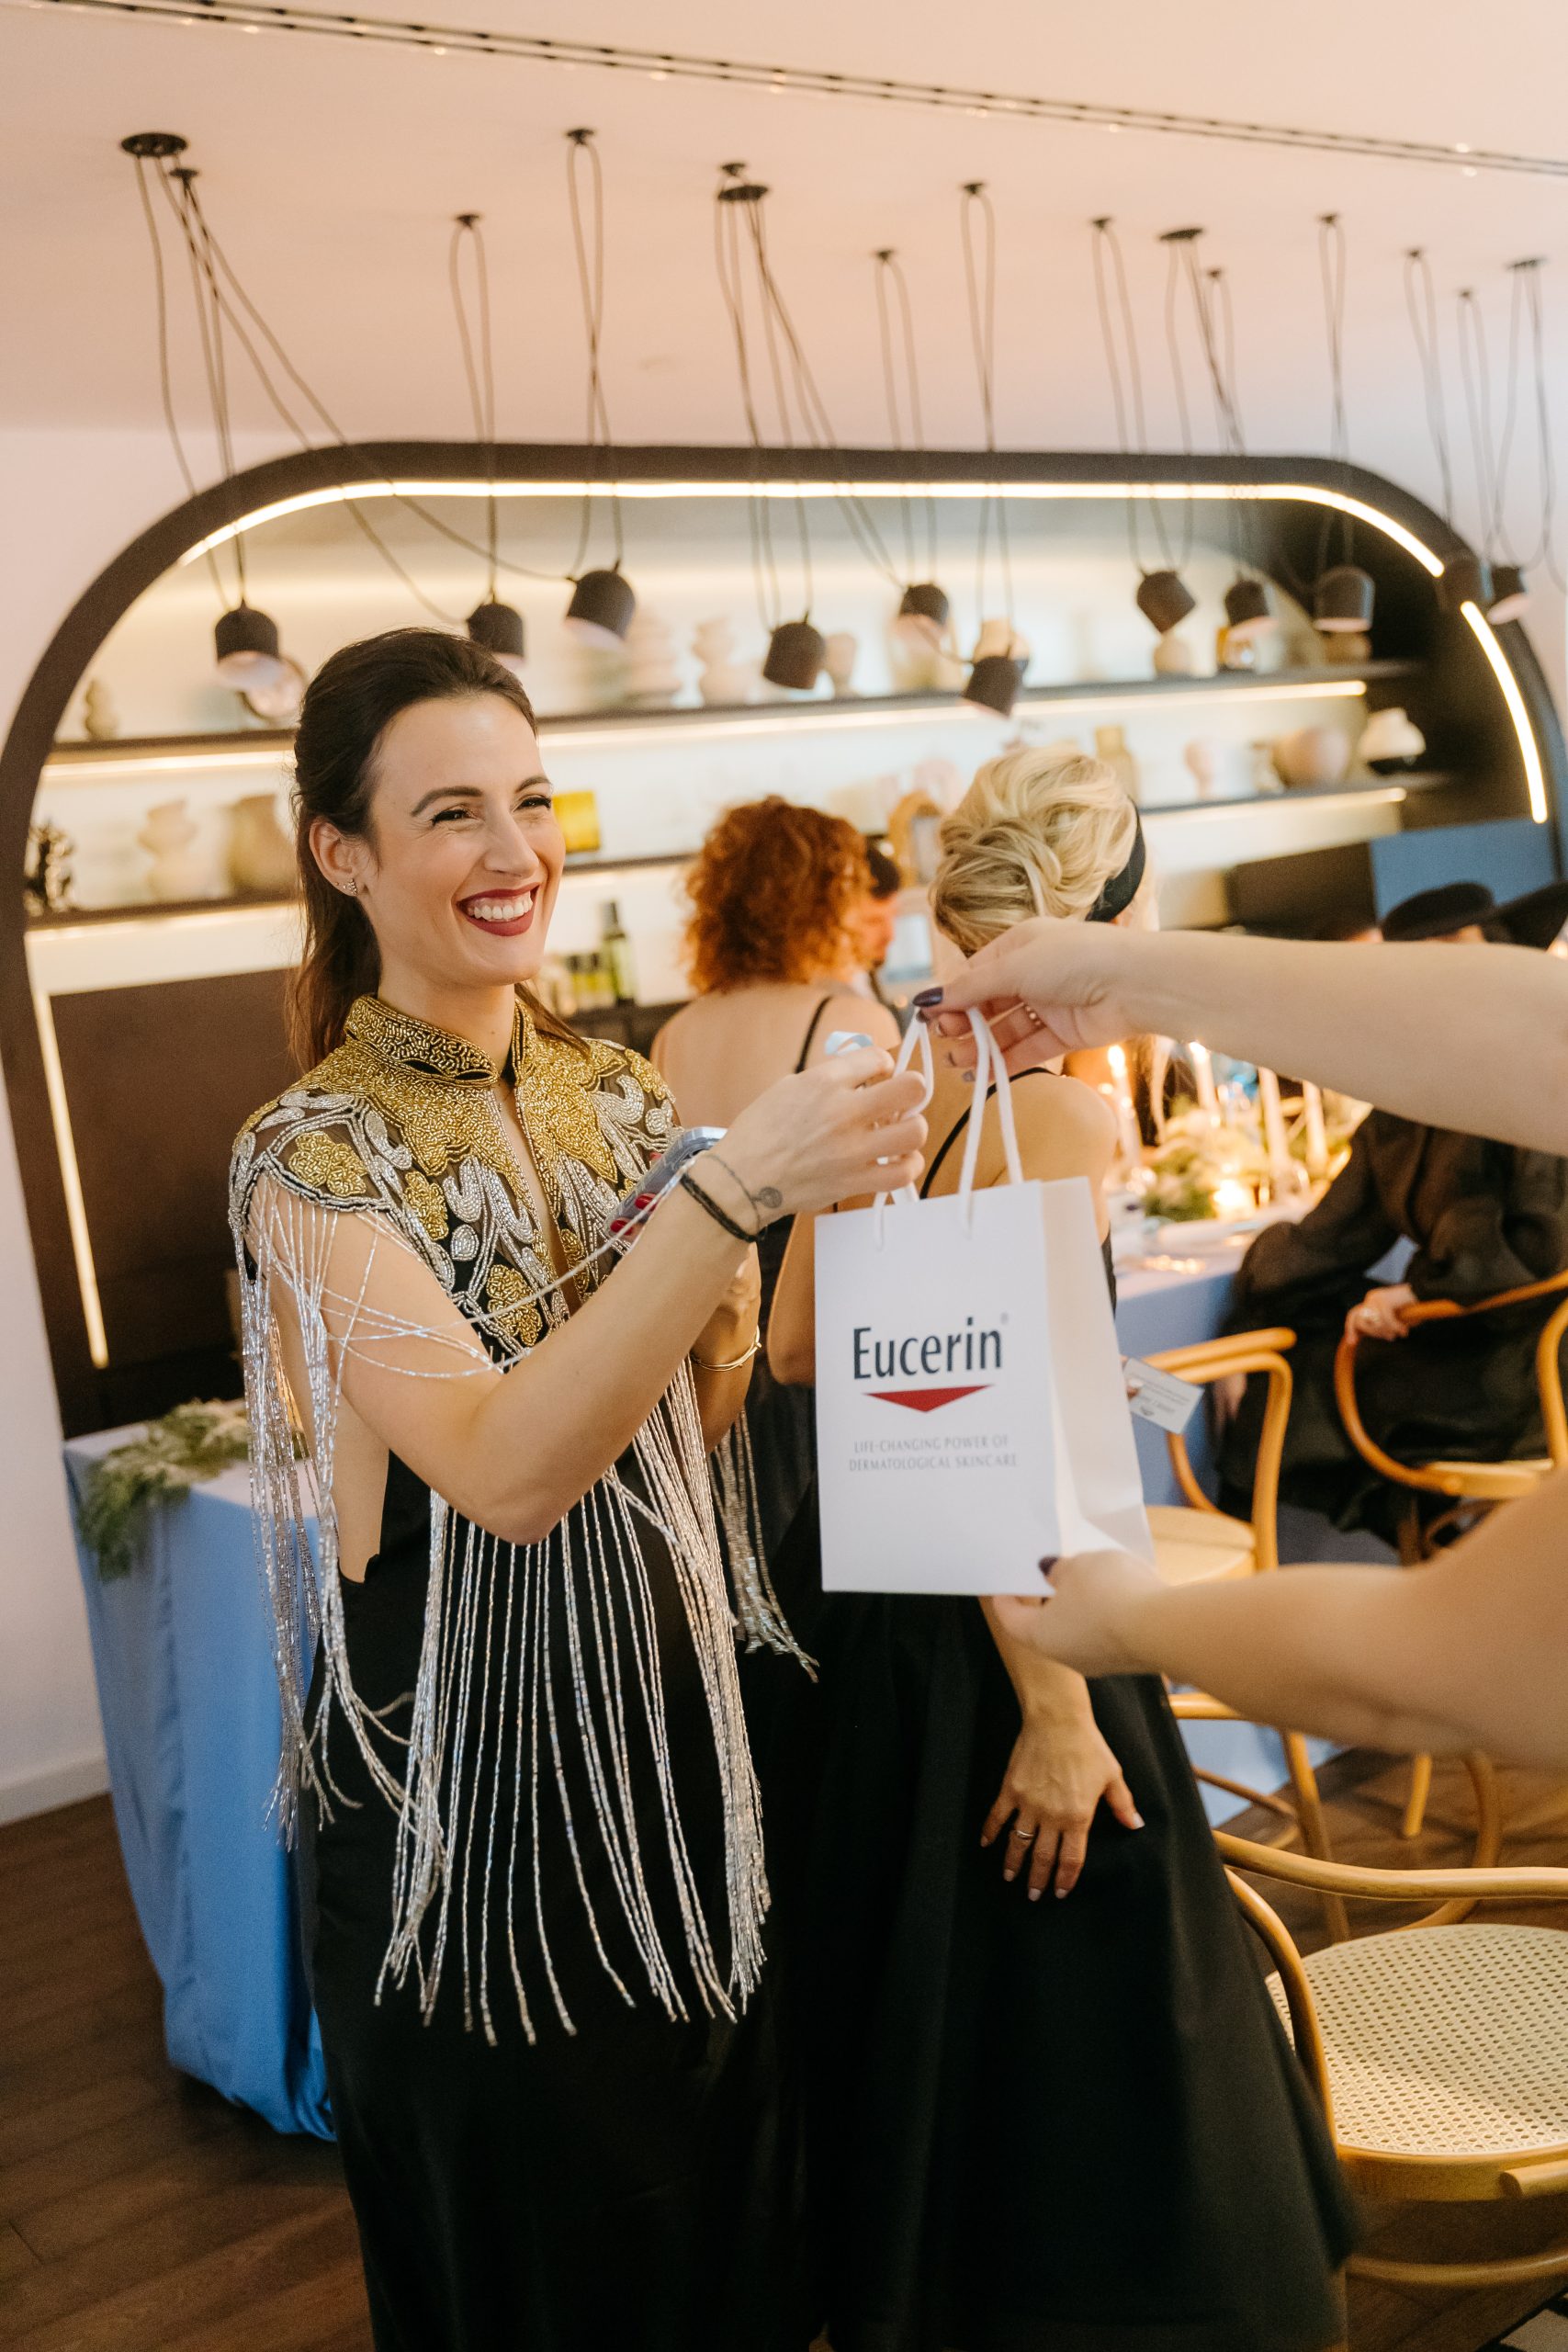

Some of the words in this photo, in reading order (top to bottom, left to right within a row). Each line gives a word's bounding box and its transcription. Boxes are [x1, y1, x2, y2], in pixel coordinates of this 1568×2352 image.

[853, 1317, 1001, 1379] Eucerin
[853, 1436, 942, 1453] LIFE-CHANGING
[944, 1435, 987, 1450] POWER
[992, 1433, 1009, 1448] OF
[849, 1455, 951, 1471] DERMATOLOGICAL
[955, 1453, 1018, 1467] SKINCARE
